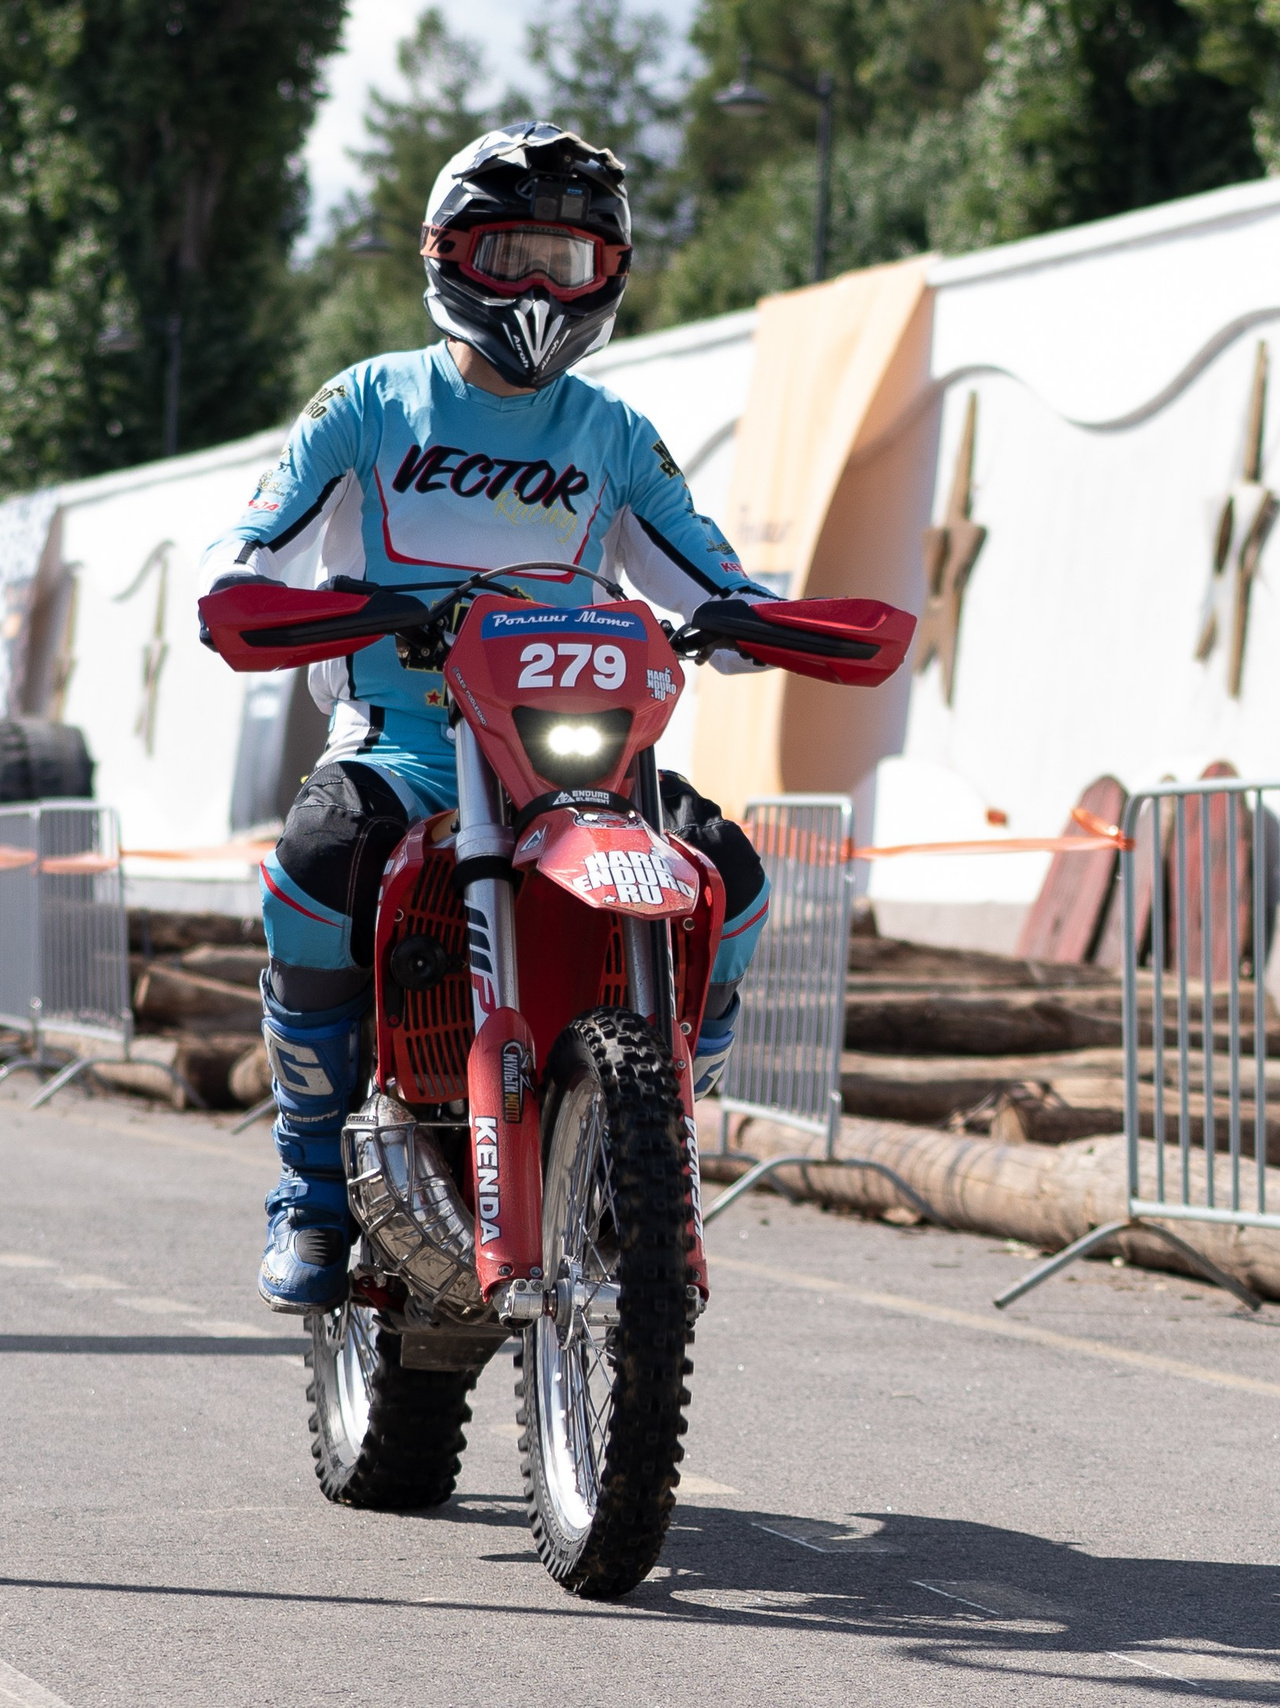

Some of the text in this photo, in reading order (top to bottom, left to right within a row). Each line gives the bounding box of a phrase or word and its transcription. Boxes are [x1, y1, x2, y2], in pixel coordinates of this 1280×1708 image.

[513, 335, 529, 369] Airoh
[392, 444, 589, 515] VECTOR
[493, 488, 578, 544] Racing
[492, 611, 635, 628] Роллинг Мото
[518, 643, 627, 690] 279
[646, 669, 671, 683] HARD
[646, 679, 677, 695] NDURO
[572, 790, 610, 800] ENDURO
[584, 850, 672, 873] HARD
[572, 867, 697, 900] ENDURO
[475, 1116, 502, 1246] KENDA
